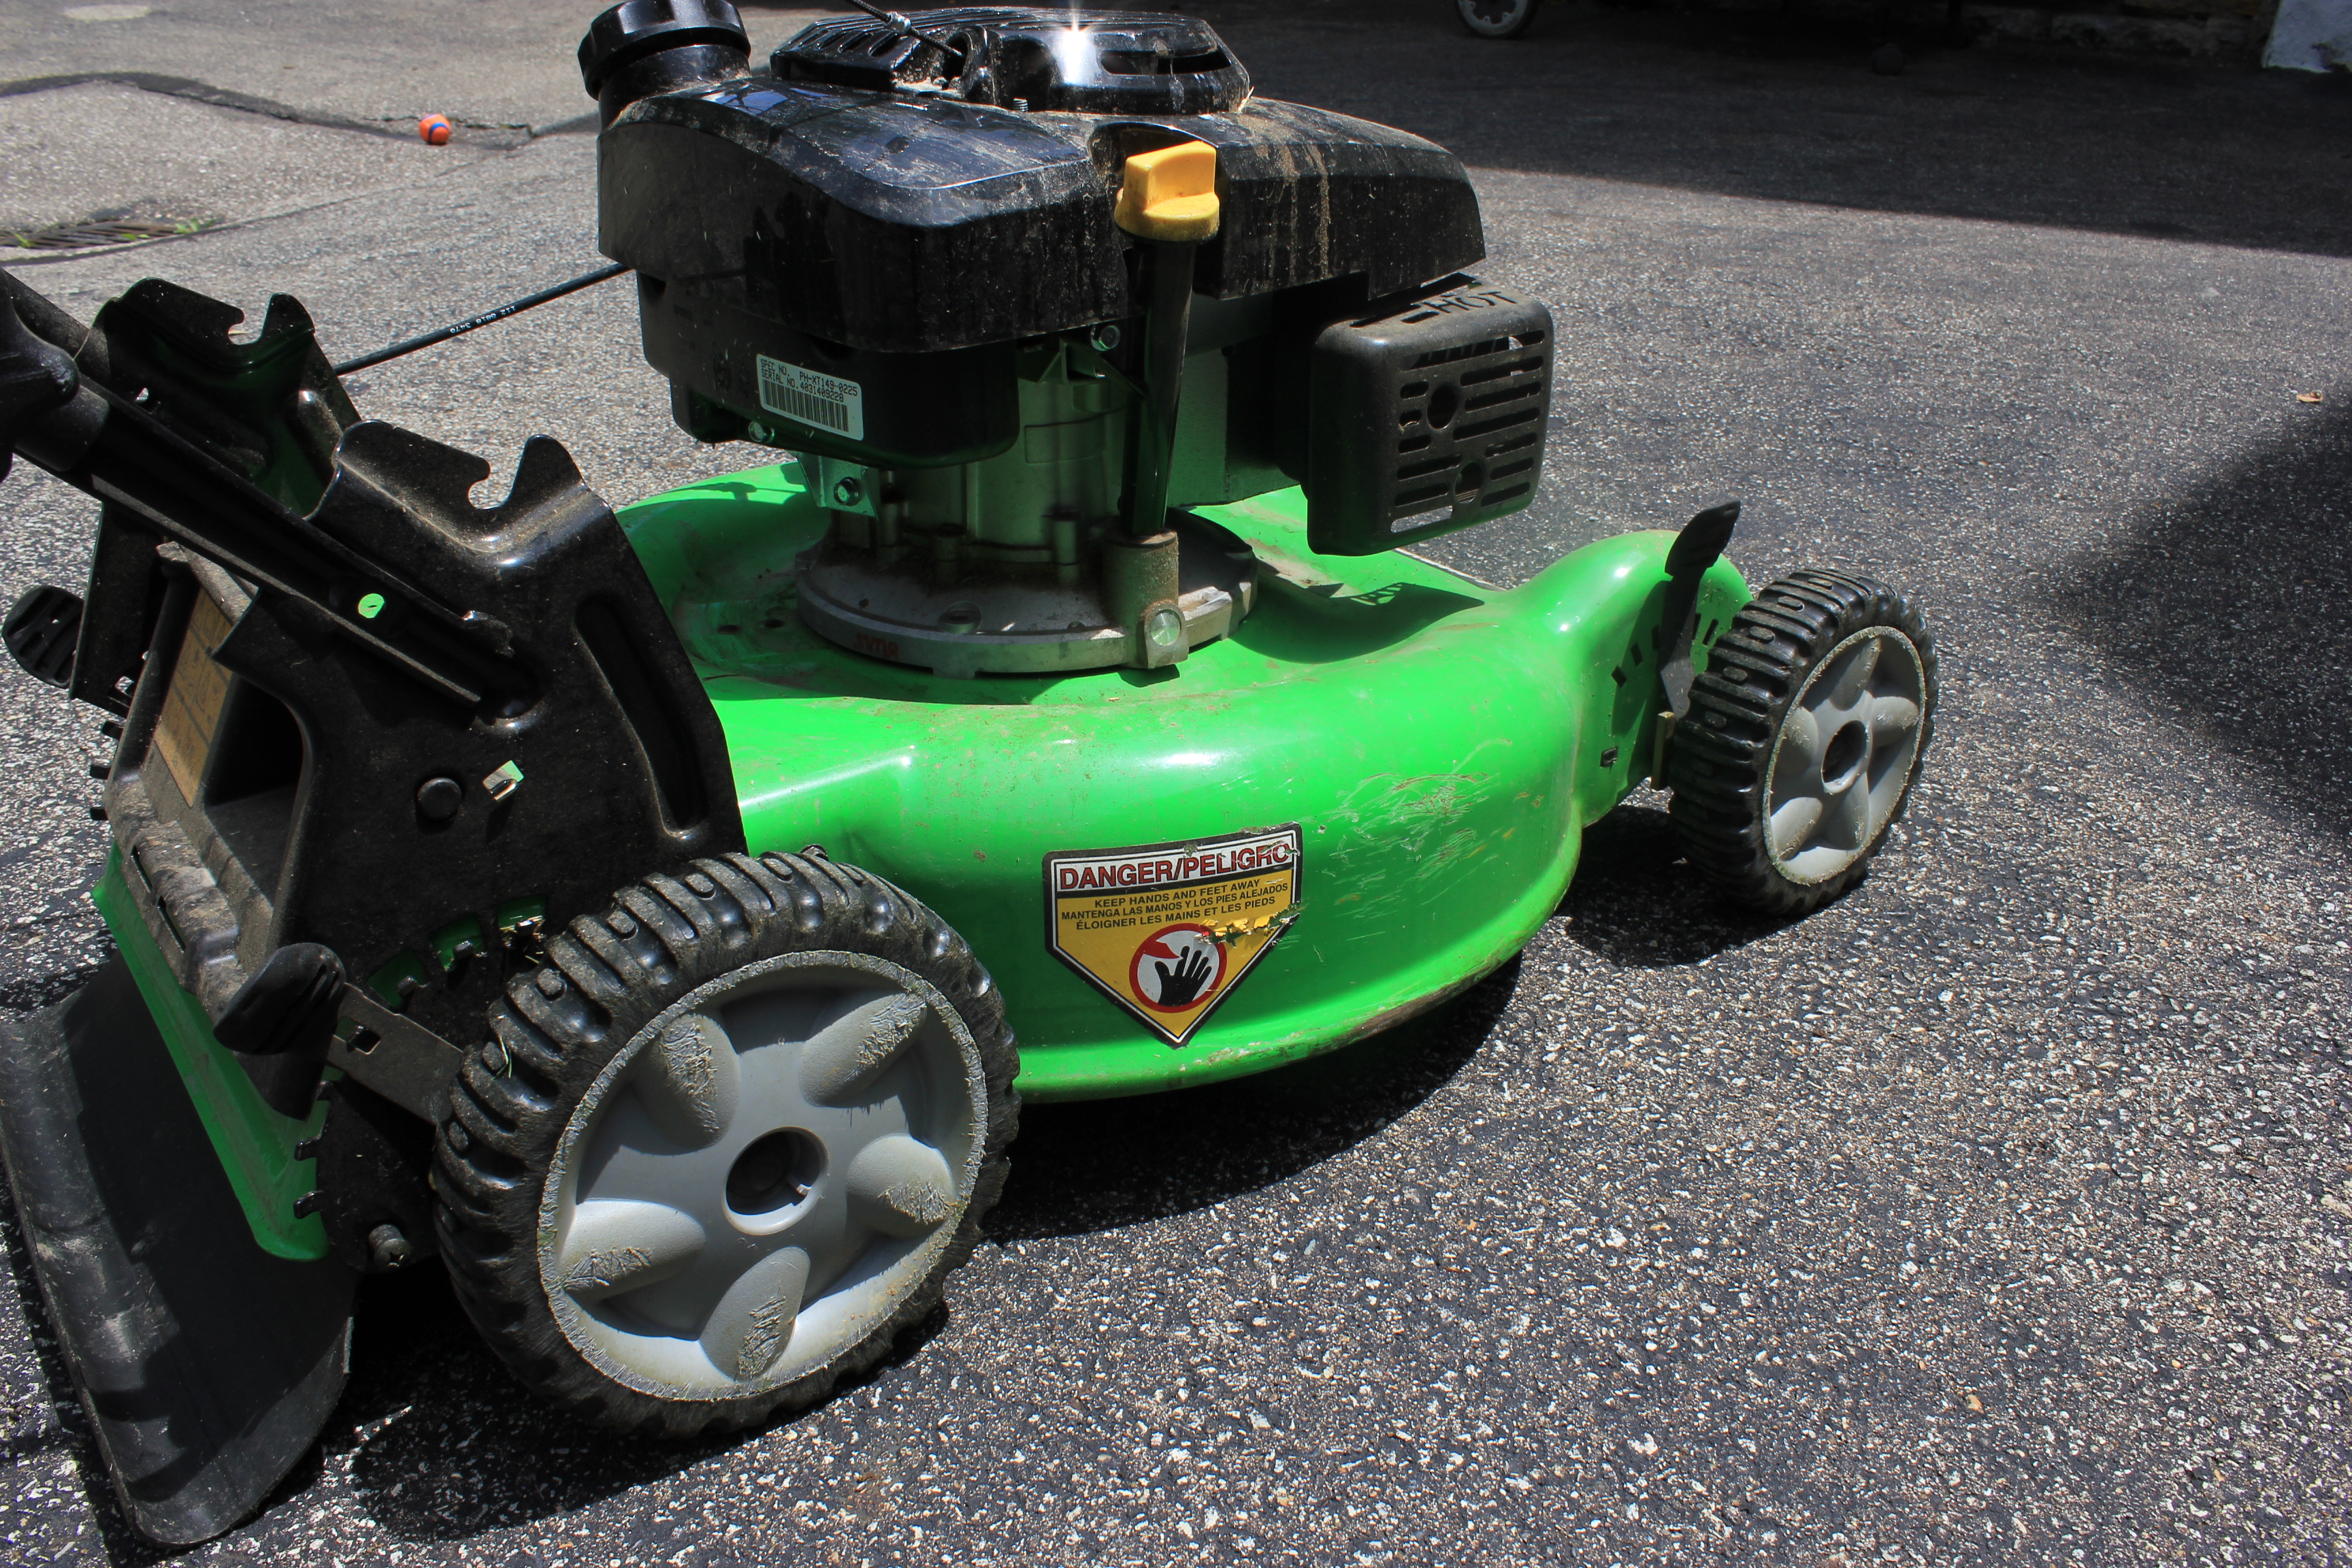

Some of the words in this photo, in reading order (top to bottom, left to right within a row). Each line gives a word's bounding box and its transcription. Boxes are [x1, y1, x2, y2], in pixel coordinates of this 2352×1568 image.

[500, 306, 517, 315] 112
[1422, 291, 1518, 314] HOT
[760, 359, 775, 372] SPEC
[779, 365, 789, 376] NO.
[799, 371, 858, 396] PH-XT149-0225
[761, 368, 783, 385] SERIAL
[787, 378, 798, 389] NO.
[800, 382, 844, 402] 4031409228
[1060, 843, 1291, 889] DANGER/PELIGRO
[1062, 909, 1120, 920] MANTENGA
[1123, 906, 1143, 916] LAS
[1145, 902, 1182, 913] MANOS
[1185, 900, 1191, 909] Y
[1194, 897, 1213, 907] LOS
[1216, 893, 1237, 904] PIES
[1239, 883, 1288, 900] ALEJADOS
[1095, 898, 1126, 908] KEEP
[1130, 894, 1169, 905] HANDS
[1173, 889, 1196, 900] AND
[1200, 885, 1228, 896] FEET
[1230, 879, 1260, 892] AWAY
[1076, 917, 1136, 930] ÉLOIGNER
[1140, 915, 1162, 925] LES
[1165, 910, 1200, 922] MAINS
[1204, 907, 1218, 916] ET
[1221, 903, 1241, 913] LES
[1245, 896, 1275, 909] PIEDS
